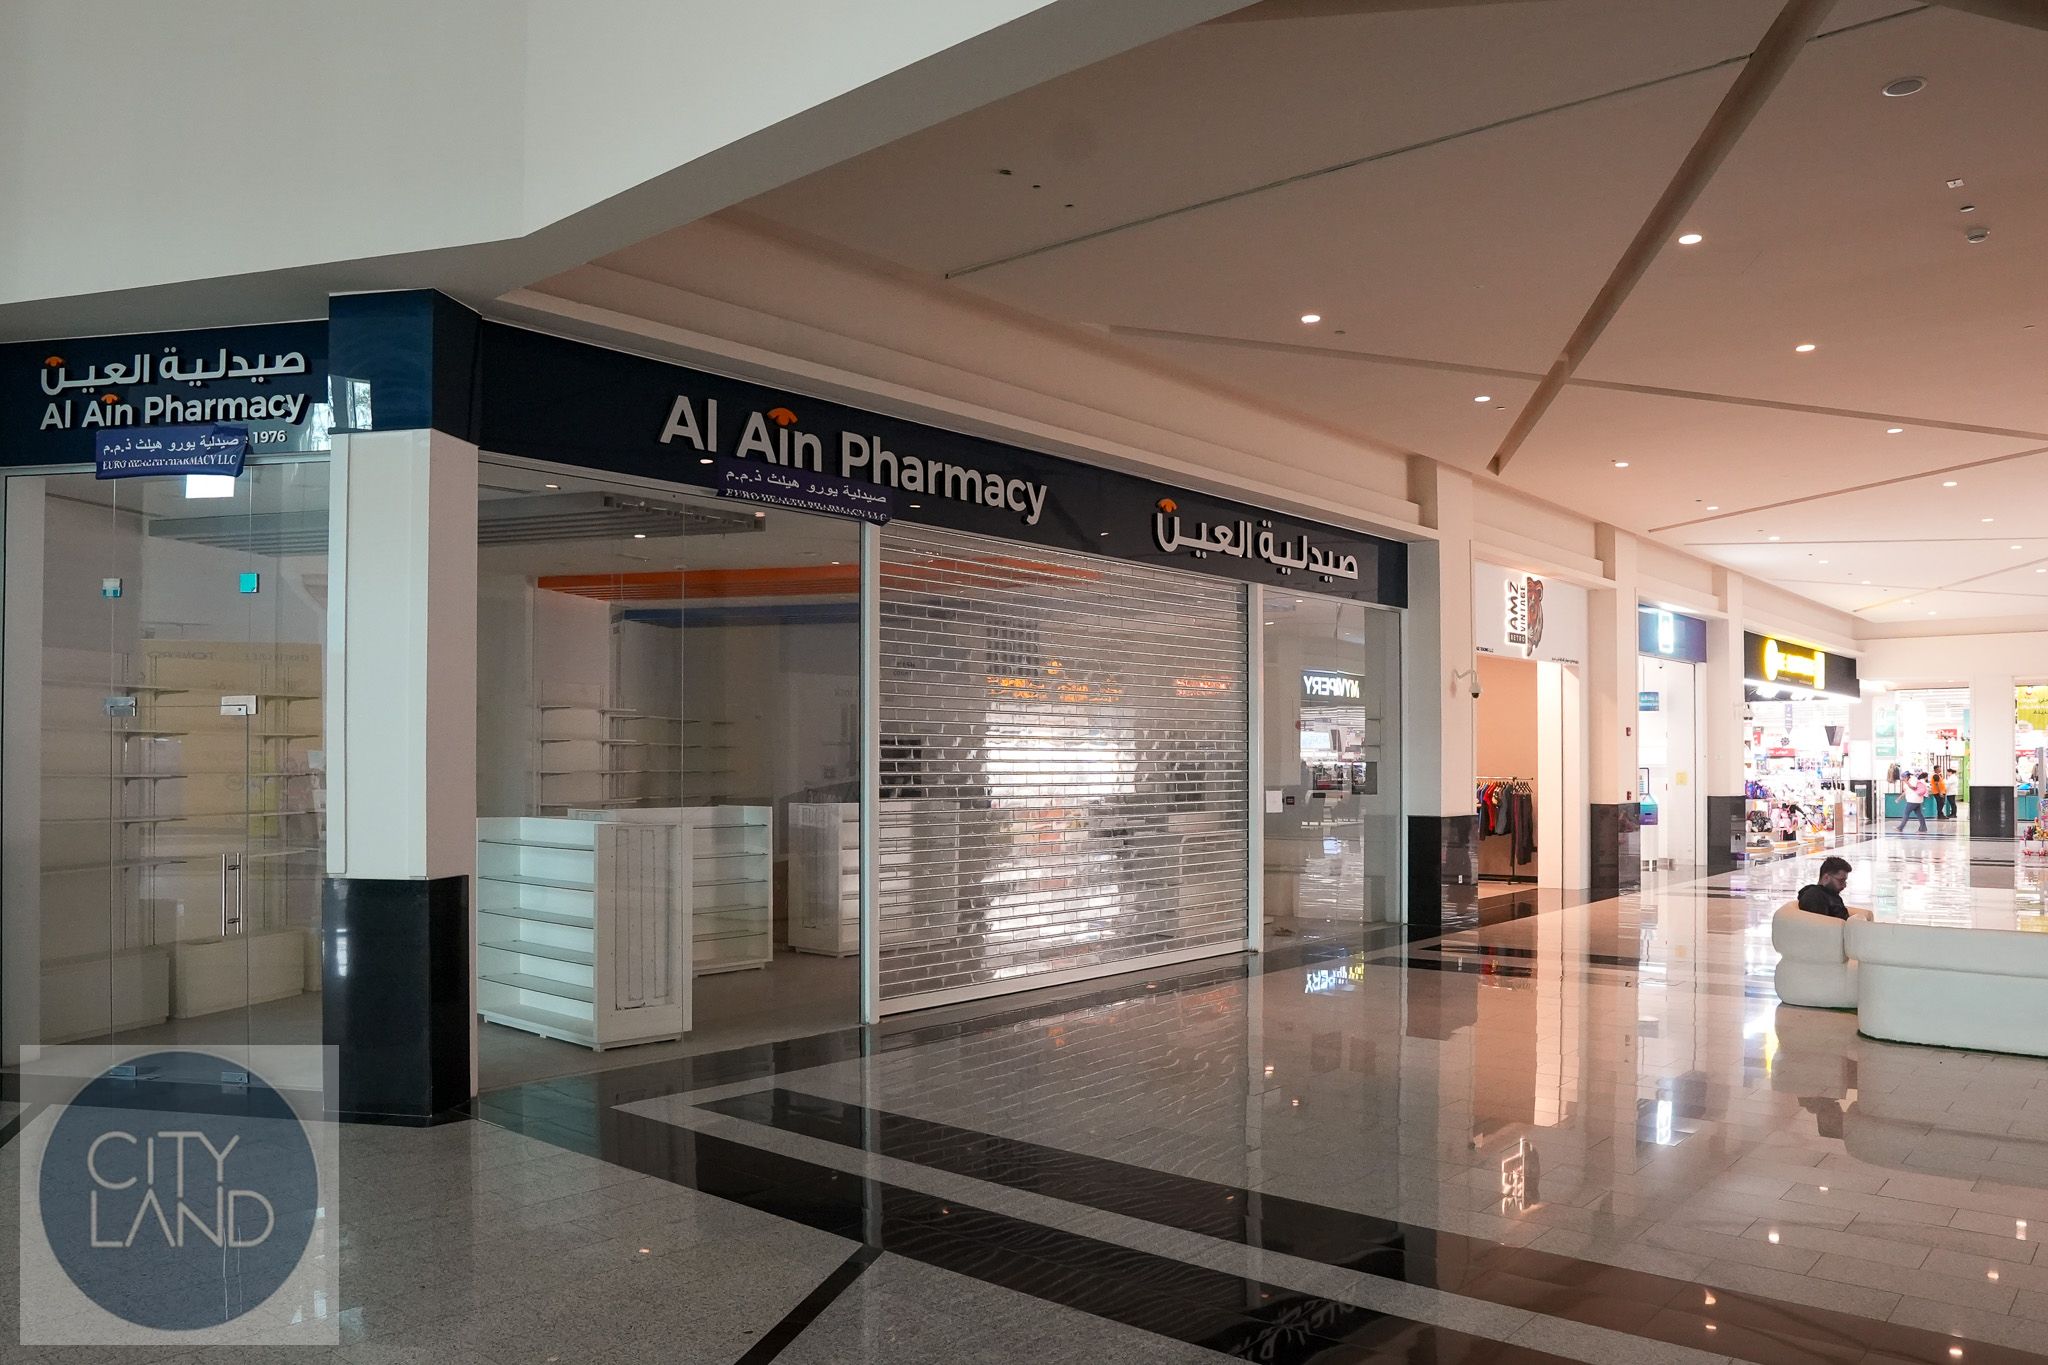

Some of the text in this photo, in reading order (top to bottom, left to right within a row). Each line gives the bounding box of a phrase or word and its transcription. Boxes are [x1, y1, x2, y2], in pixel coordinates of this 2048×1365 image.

[40, 347, 306, 396] صيدلية العين
[40, 393, 305, 430] Al Ain Pharmacy
[252, 430, 286, 444] 1976
[218, 454, 237, 465] LLC
[659, 395, 1048, 526] Al Ain Pharmacy
[726, 488, 760, 500] EURO
[1157, 499, 1359, 583] صيدلية العين
